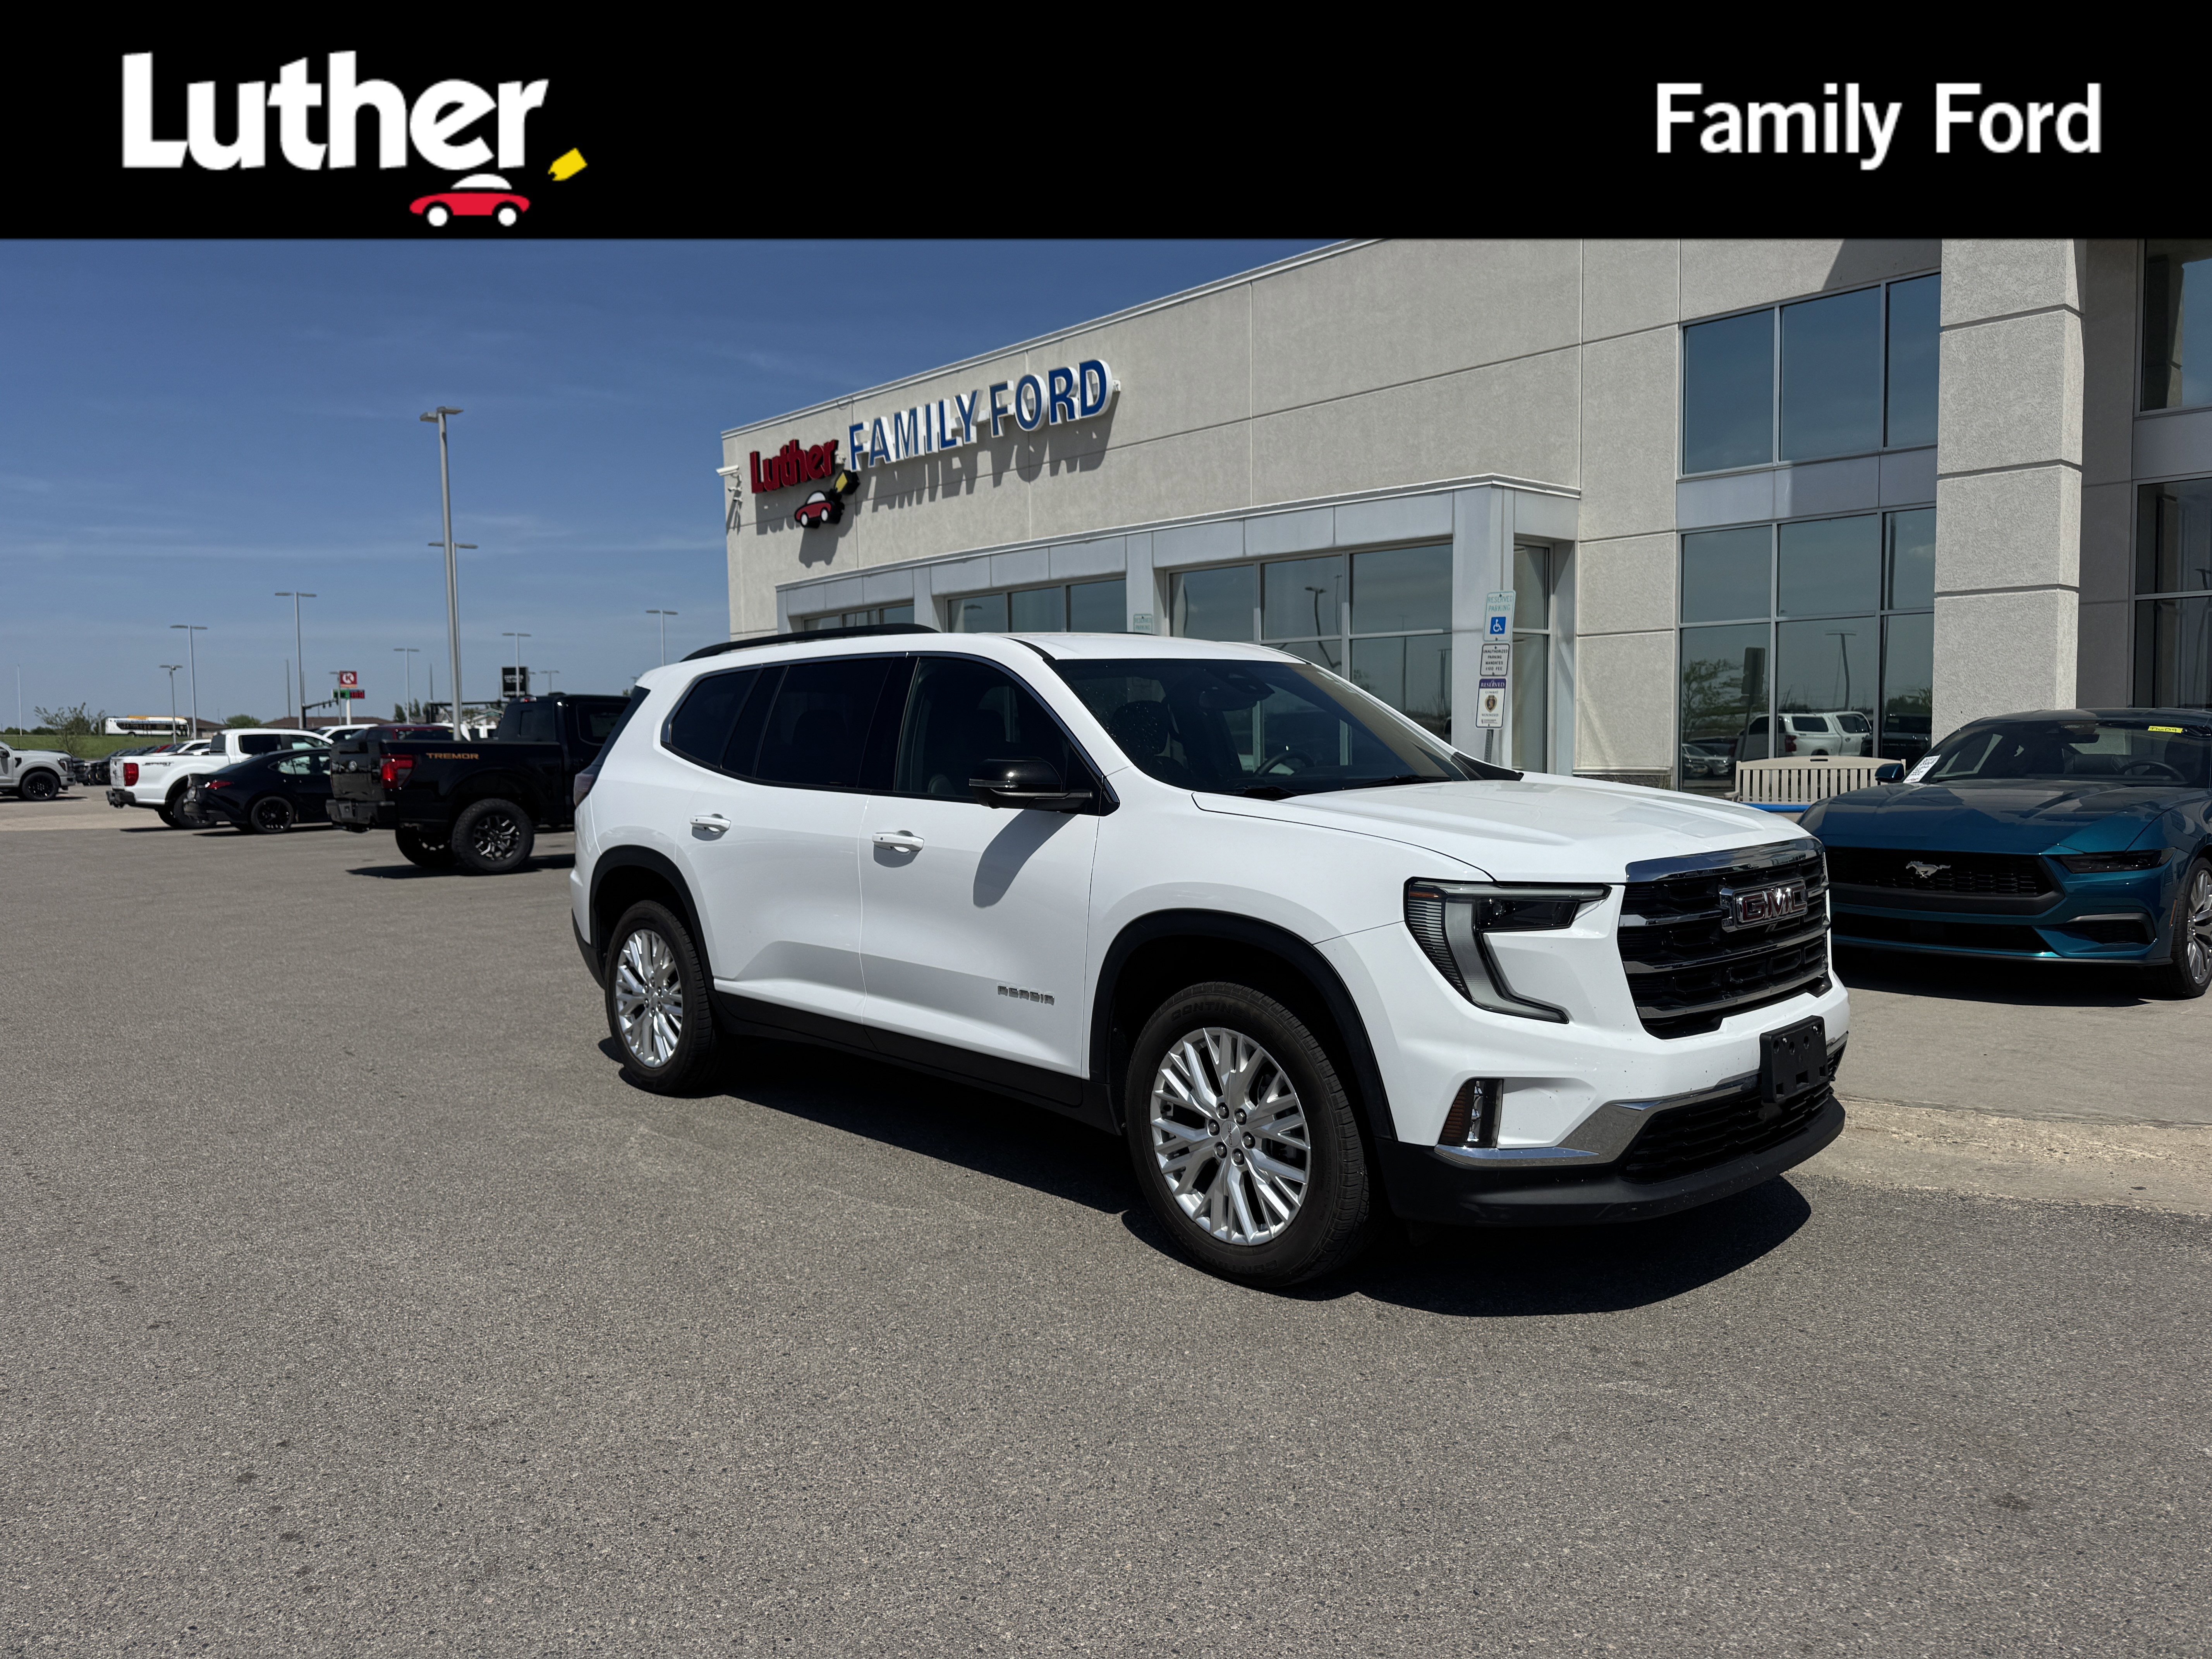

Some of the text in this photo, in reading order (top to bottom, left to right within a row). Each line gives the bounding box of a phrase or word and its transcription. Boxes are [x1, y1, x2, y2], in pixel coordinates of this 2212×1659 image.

[848, 359, 1113, 472] FAMILY FORD
[750, 439, 839, 493] Luther
[1736, 883, 1808, 922] GMC
[997, 985, 1054, 1006] ACADIA
